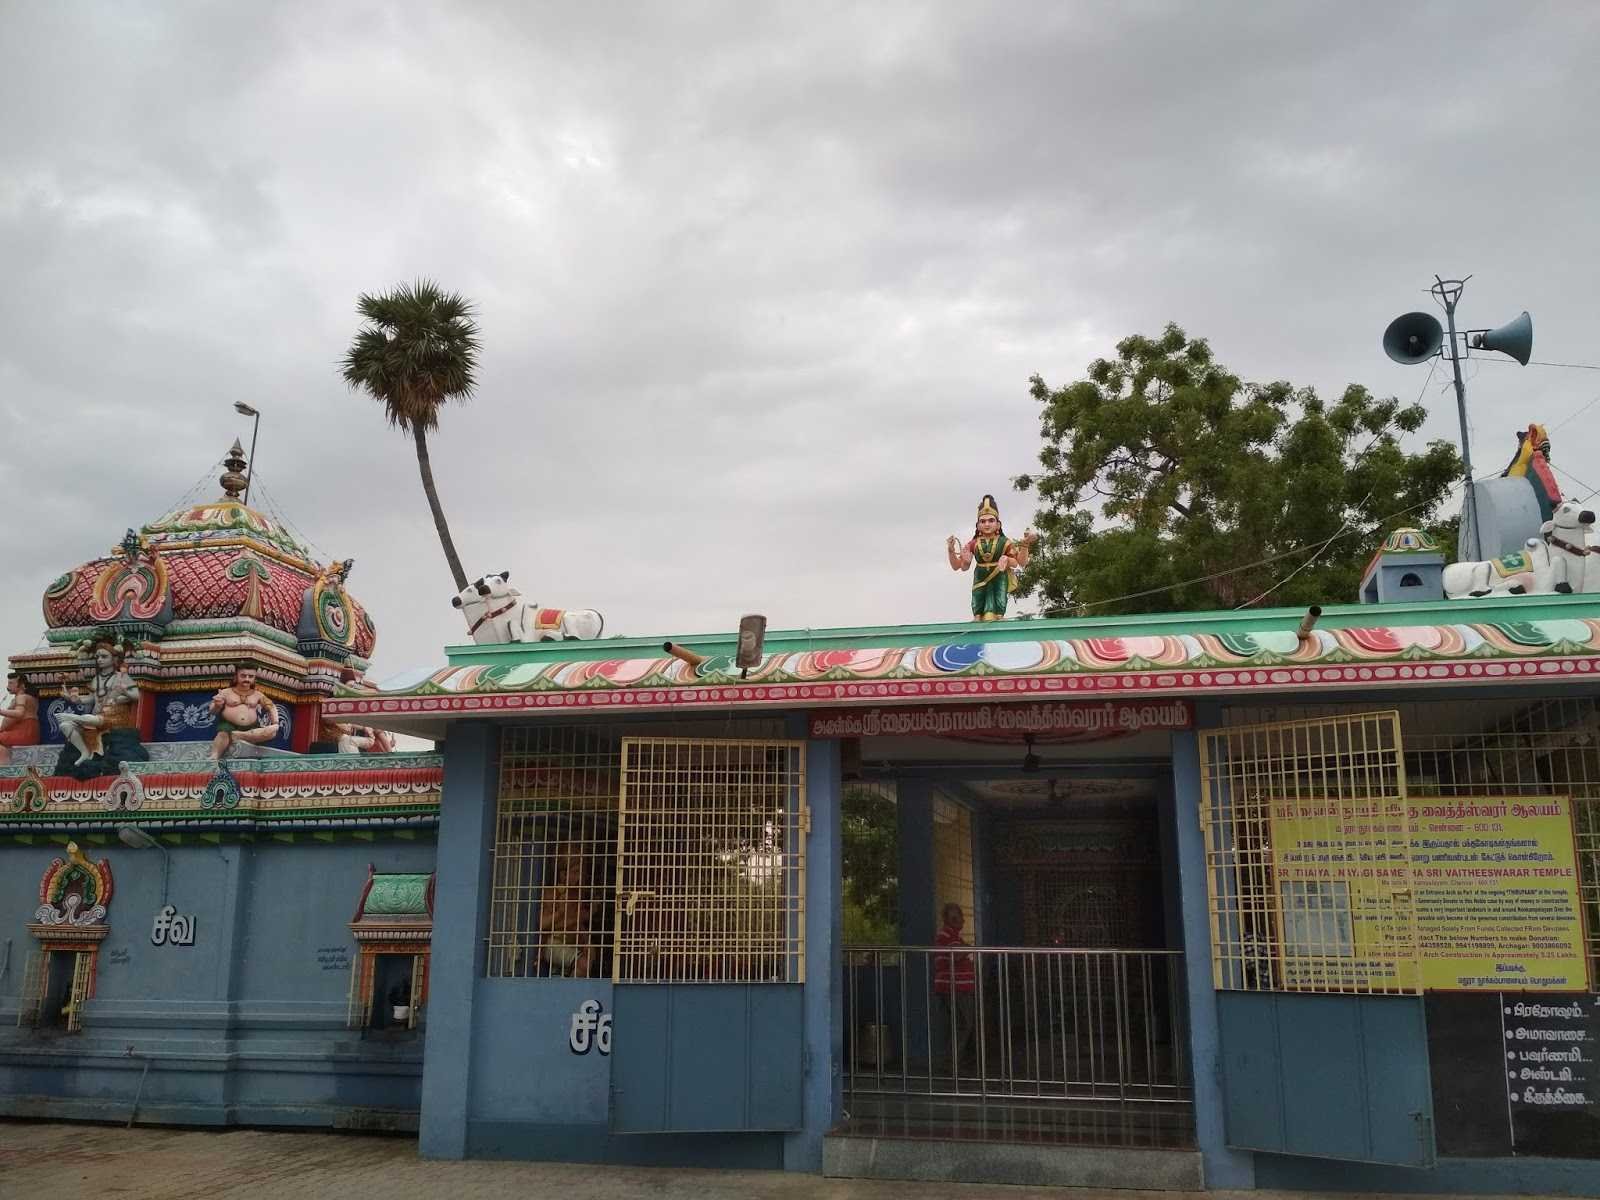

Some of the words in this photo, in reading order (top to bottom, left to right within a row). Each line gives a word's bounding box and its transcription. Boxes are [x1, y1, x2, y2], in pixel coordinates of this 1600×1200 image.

[1118, 700, 1188, 727] ஆலயம்
[1511, 800, 1561, 818] ஆலயம்
[1426, 868, 1442, 877] SRI
[1445, 868, 1529, 877] VAITHEESWARAR
[1533, 868, 1572, 877] TEMPLE
